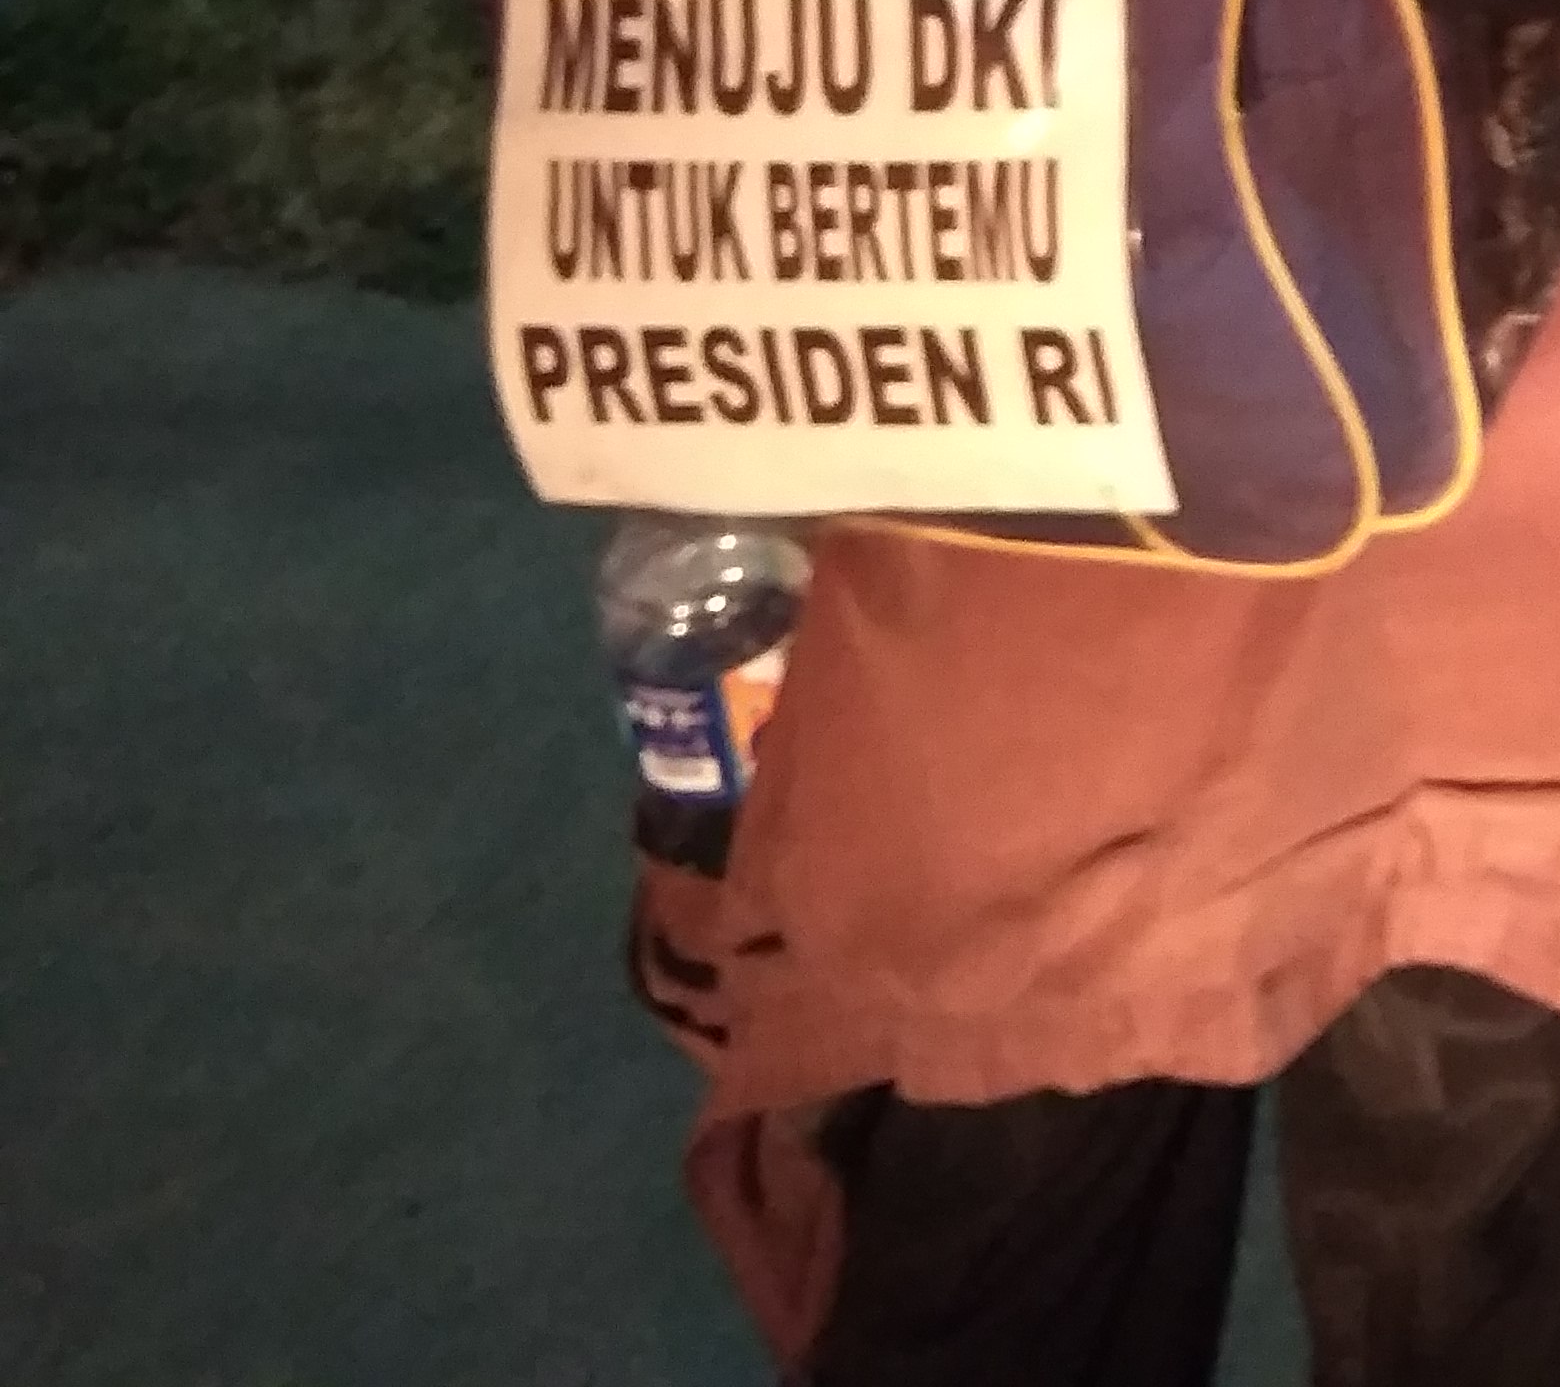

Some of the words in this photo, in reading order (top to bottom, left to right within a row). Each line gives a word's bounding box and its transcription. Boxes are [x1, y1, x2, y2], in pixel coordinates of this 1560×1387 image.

[547, 159, 751, 282] UNTUK
[766, 158, 1059, 282] BERTEMU
[518, 326, 991, 426] PRESIDEN
[1020, 326, 1119, 425] RI
